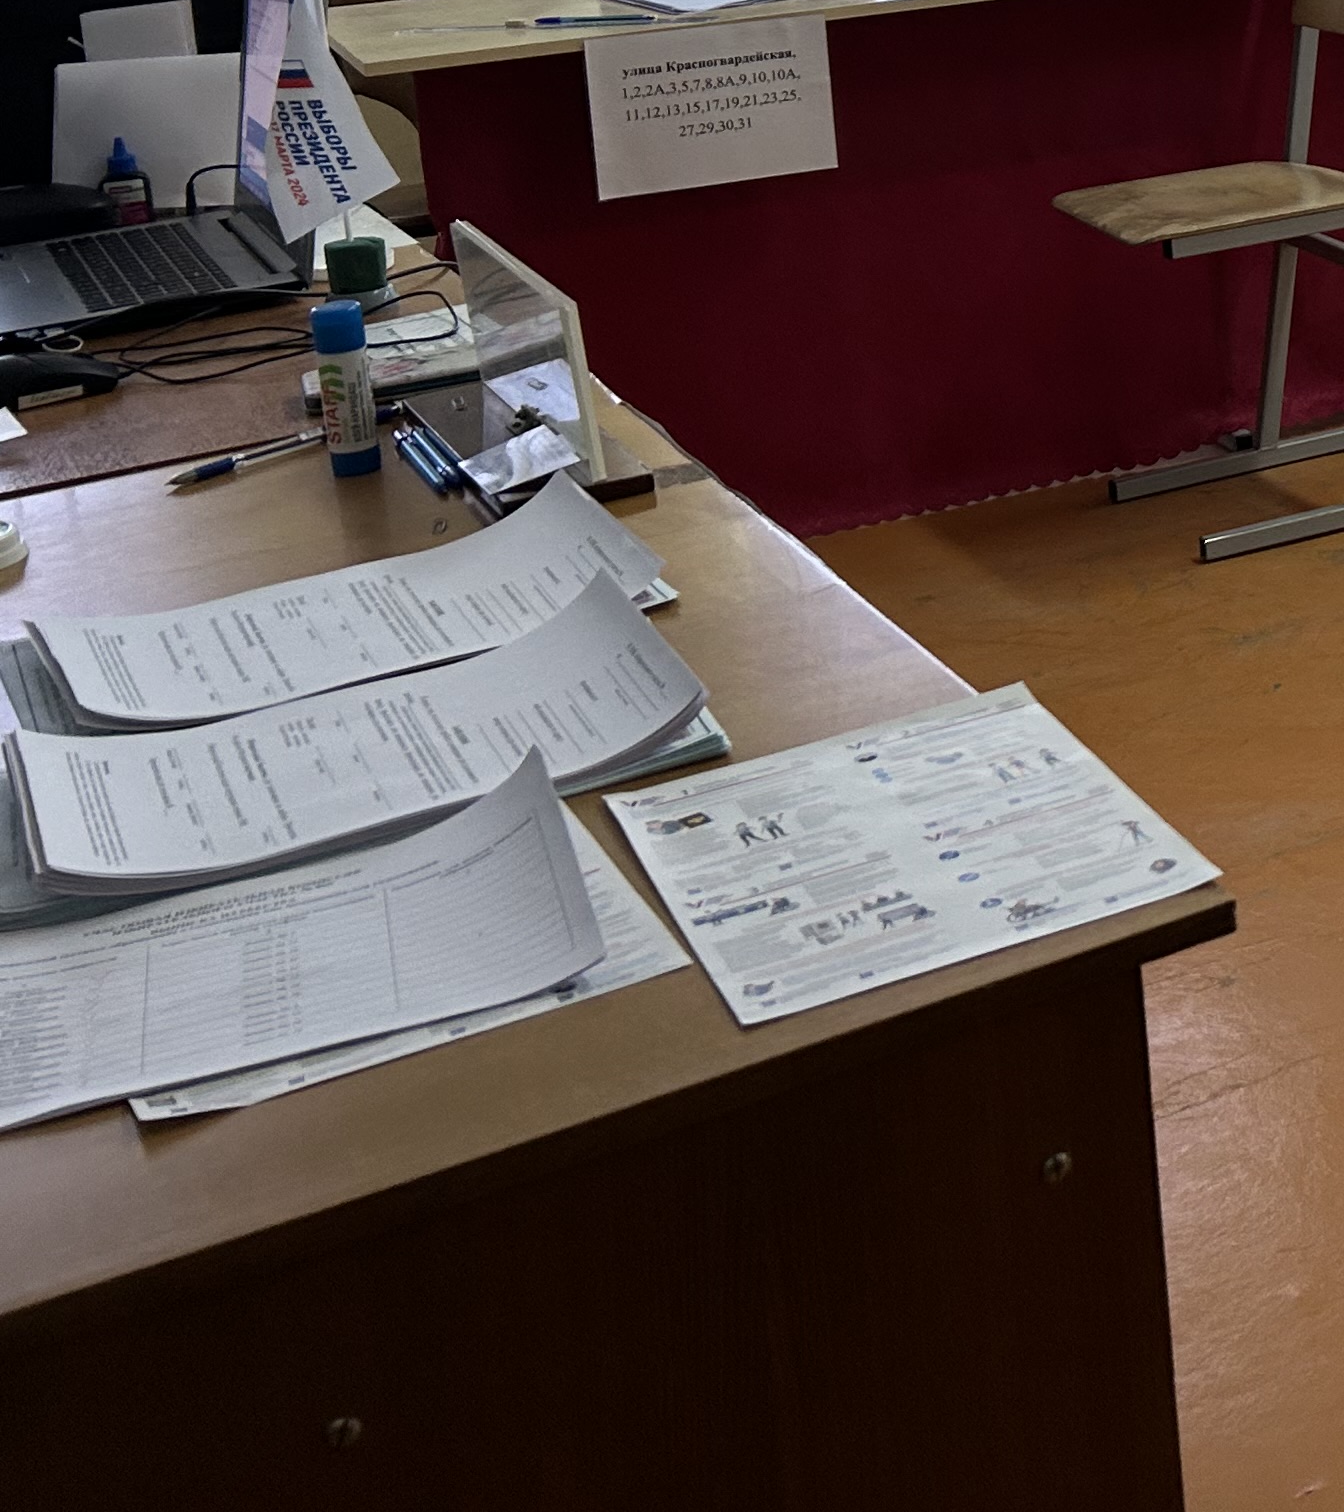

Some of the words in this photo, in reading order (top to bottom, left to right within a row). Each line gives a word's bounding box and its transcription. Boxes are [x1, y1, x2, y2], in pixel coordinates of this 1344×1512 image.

[622, 64, 663, 80] улица
[665, 49, 797, 72] Красногвардейская,
[622, 68, 801, 100] 1,2,2А,3,5,7,8,8А,9,10,10А,
[625, 90, 802, 122] 11,12,13,15,17,19,21,23,25,
[678, 116, 753, 138] 27,29,30,31
[275, 100, 310, 168] РОССИИ
[288, 100, 351, 205] ПРЕЗИДЕНТА
[307, 99, 357, 172] ВЫБОРЫ
[274, 135, 293, 177] МАРТА
[287, 177, 310, 207] 2024
